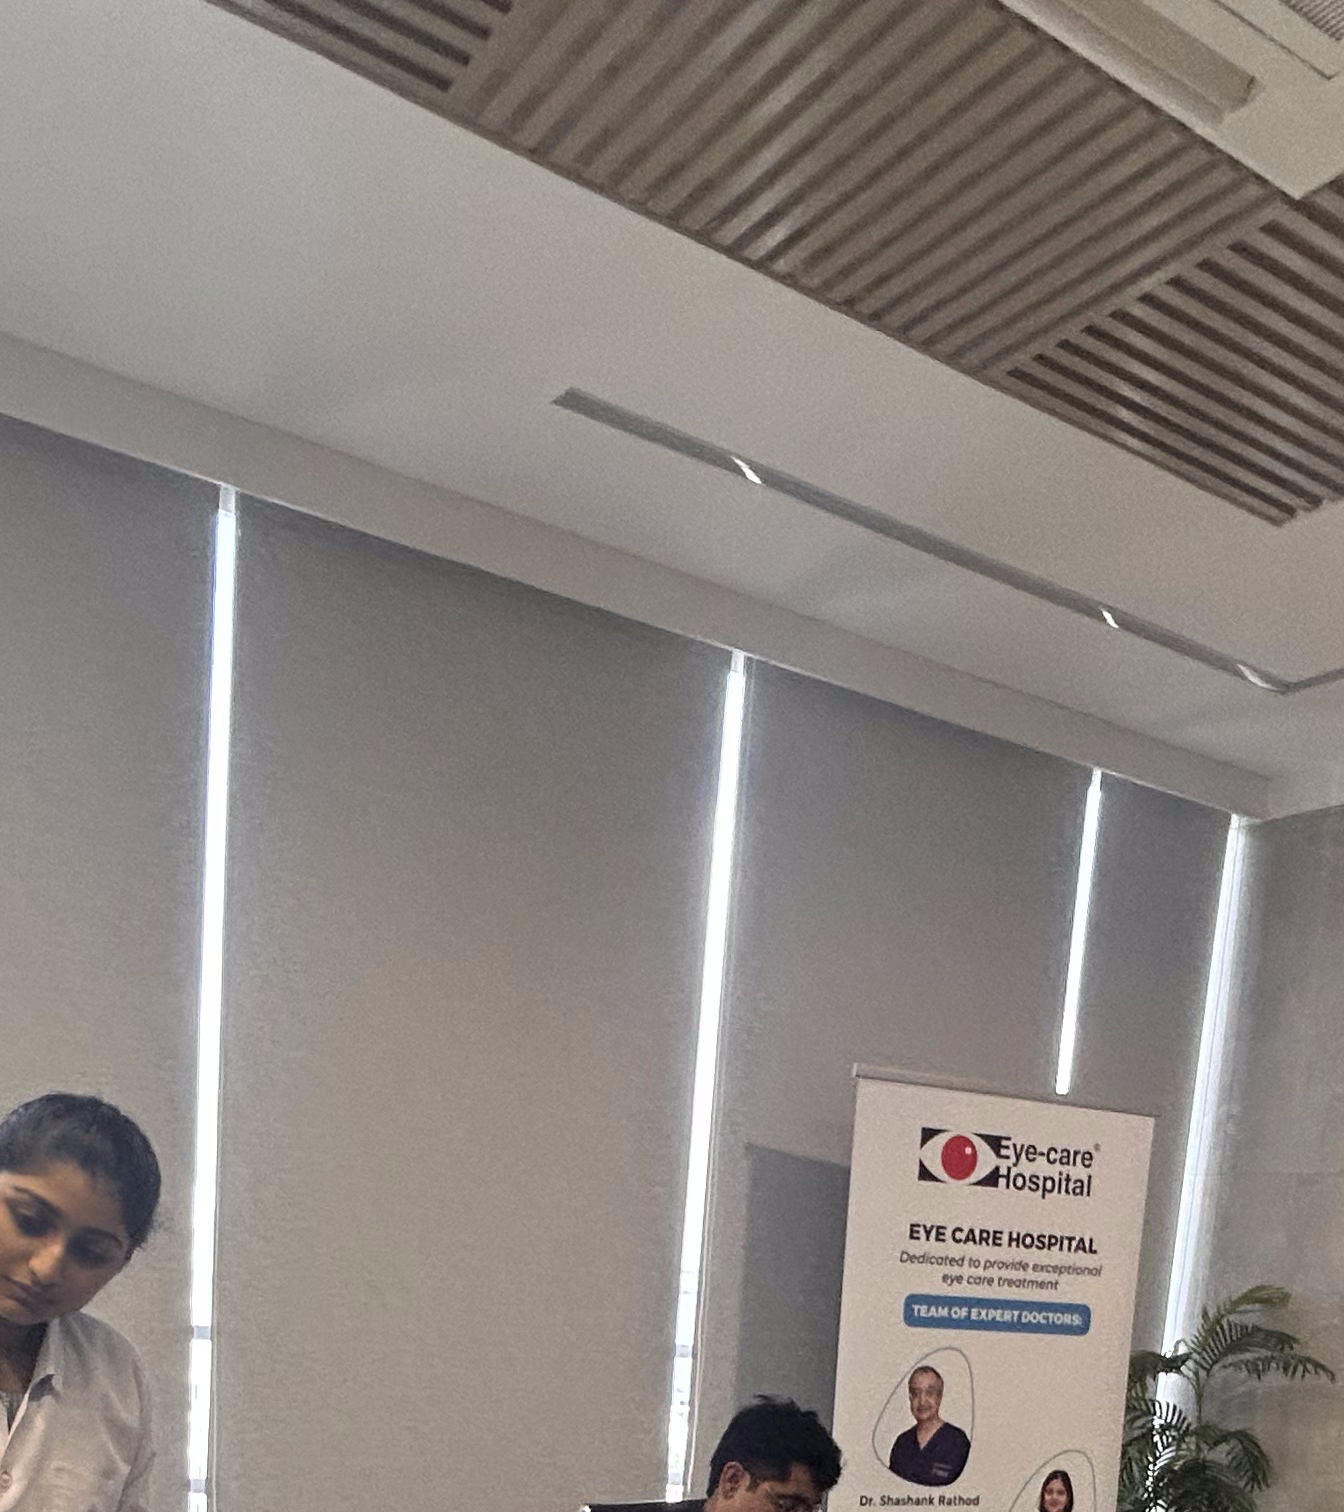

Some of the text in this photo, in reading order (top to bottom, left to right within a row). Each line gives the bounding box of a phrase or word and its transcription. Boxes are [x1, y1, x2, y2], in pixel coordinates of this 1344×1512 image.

[997, 1165, 1092, 1200] Hospital
[908, 1223, 1098, 1255] EYE CARE HOSPITAL
[899, 1250, 1103, 1278] Dedicated to provide exceptional
[941, 1273, 1060, 1291] eye care treatment
[911, 1303, 949, 1319] TEAM
[951, 1306, 969, 1320] OF
[970, 1307, 1019, 1324] EXPERT
[859, 1493, 980, 1507] Dr. Shashank Rathod
